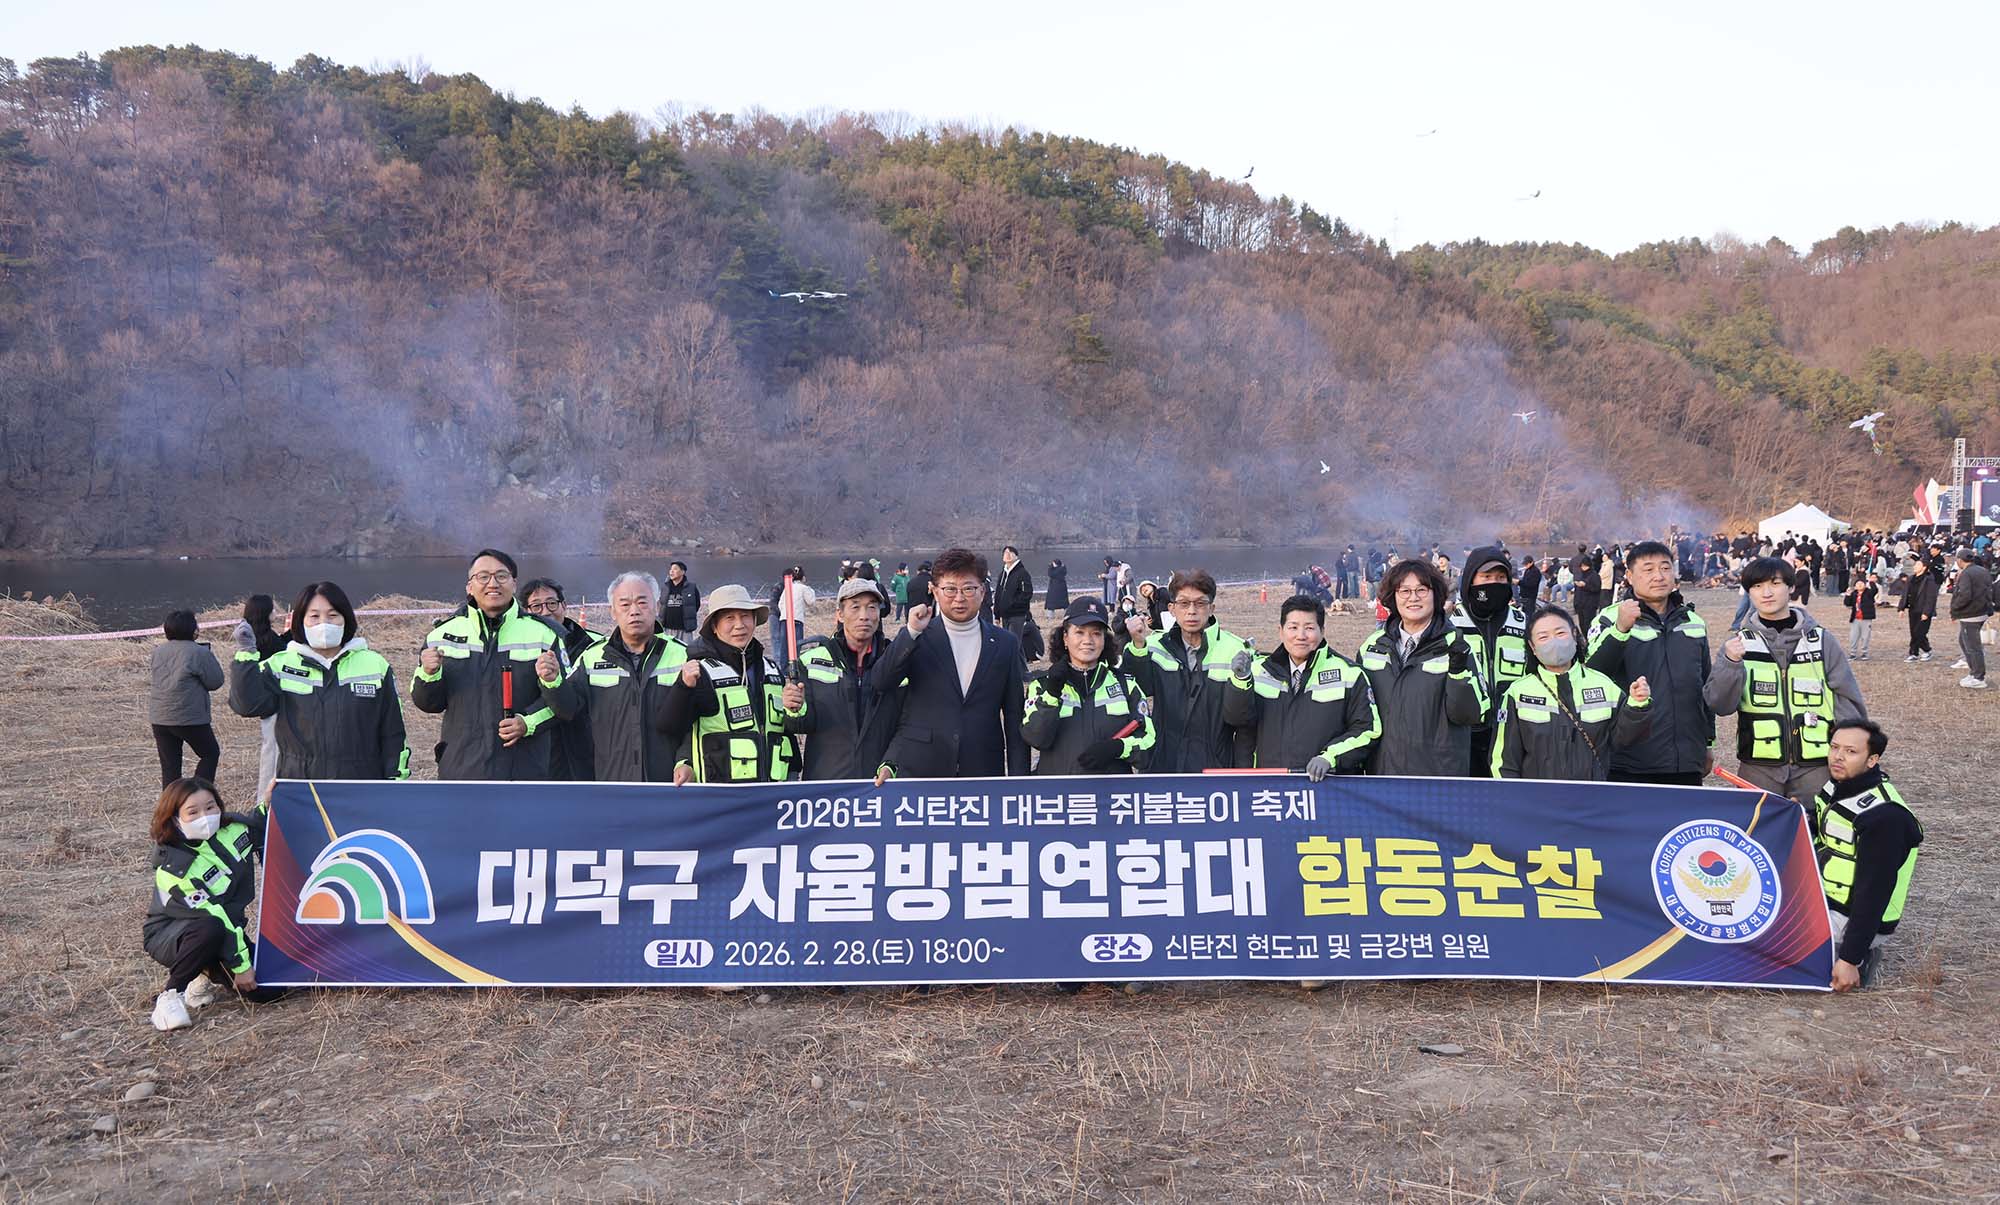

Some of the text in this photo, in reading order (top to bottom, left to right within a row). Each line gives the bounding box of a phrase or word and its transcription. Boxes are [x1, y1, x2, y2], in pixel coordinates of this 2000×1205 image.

[777, 787, 1317, 830] 2026년 신탄진 대보름 쥐불놀이 축제
[1658, 826, 1769, 875] KOREA CITIZENS ON PATROL
[476, 836, 1602, 925] 대덕구 자율방범연합대 합동순찰
[1711, 905, 1732, 913] 대한민국
[656, 937, 1005, 967] 일시 2026. 2. 28.(토) 18:00~
[1093, 933, 1491, 961] 장소 신탄진 현도교 및 금강변 일원
